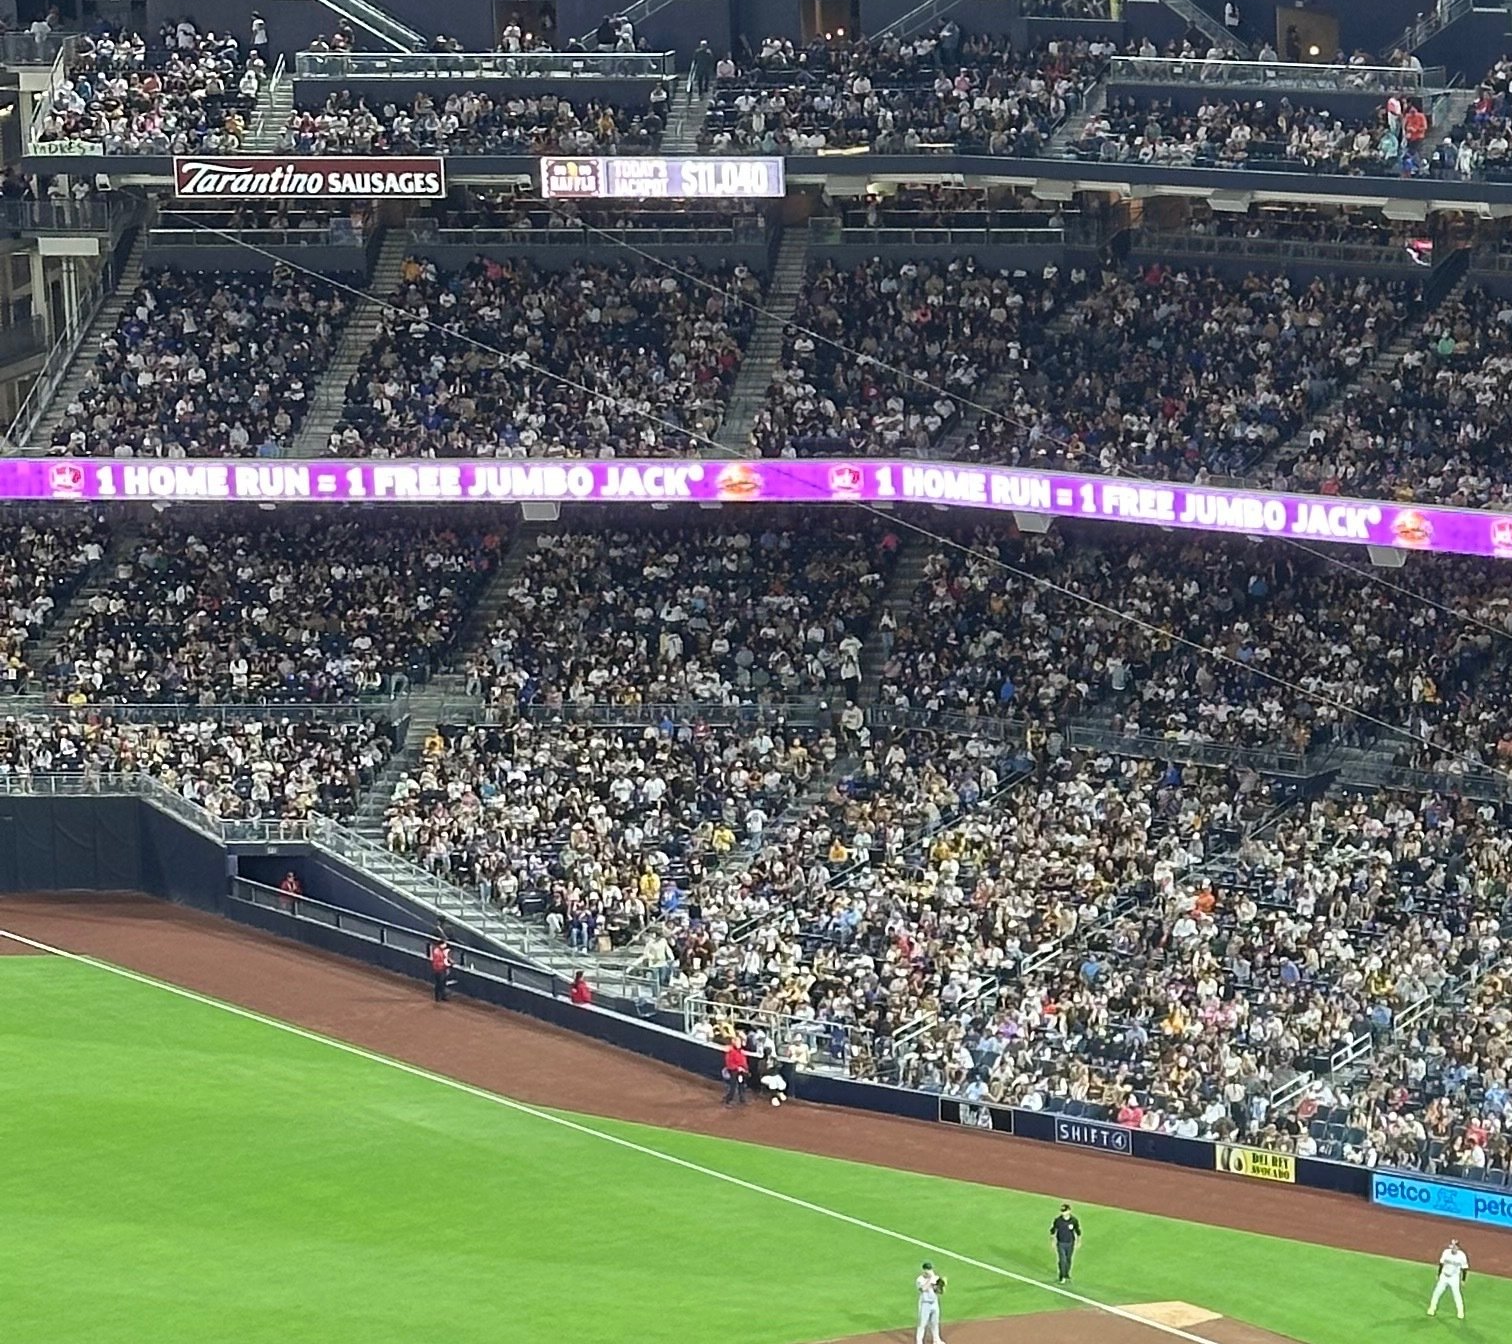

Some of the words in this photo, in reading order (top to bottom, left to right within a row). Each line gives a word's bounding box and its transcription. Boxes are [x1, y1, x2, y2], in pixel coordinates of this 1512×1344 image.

[181, 162, 323, 194] Tarantino
[328, 172, 439, 194] SAUSAGES
[681, 161, 769, 195] $11,040
[96, 466, 117, 495] 1
[123, 466, 229, 496] HOME
[234, 466, 310, 496] RUN
[346, 466, 366, 496] 1
[374, 466, 460, 497] FREE
[468, 466, 594, 497] JUMBO
[876, 467, 896, 496] 1
[903, 467, 986, 502] HOME
[991, 476, 1051, 509] RUN
[1080, 483, 1097, 513] 1
[1102, 484, 1175, 521] FREE
[1180, 493, 1287, 531] JUMBO
[1252, 1166, 1290, 1179] AVOCADO
[1375, 1179, 1431, 1203] petco
